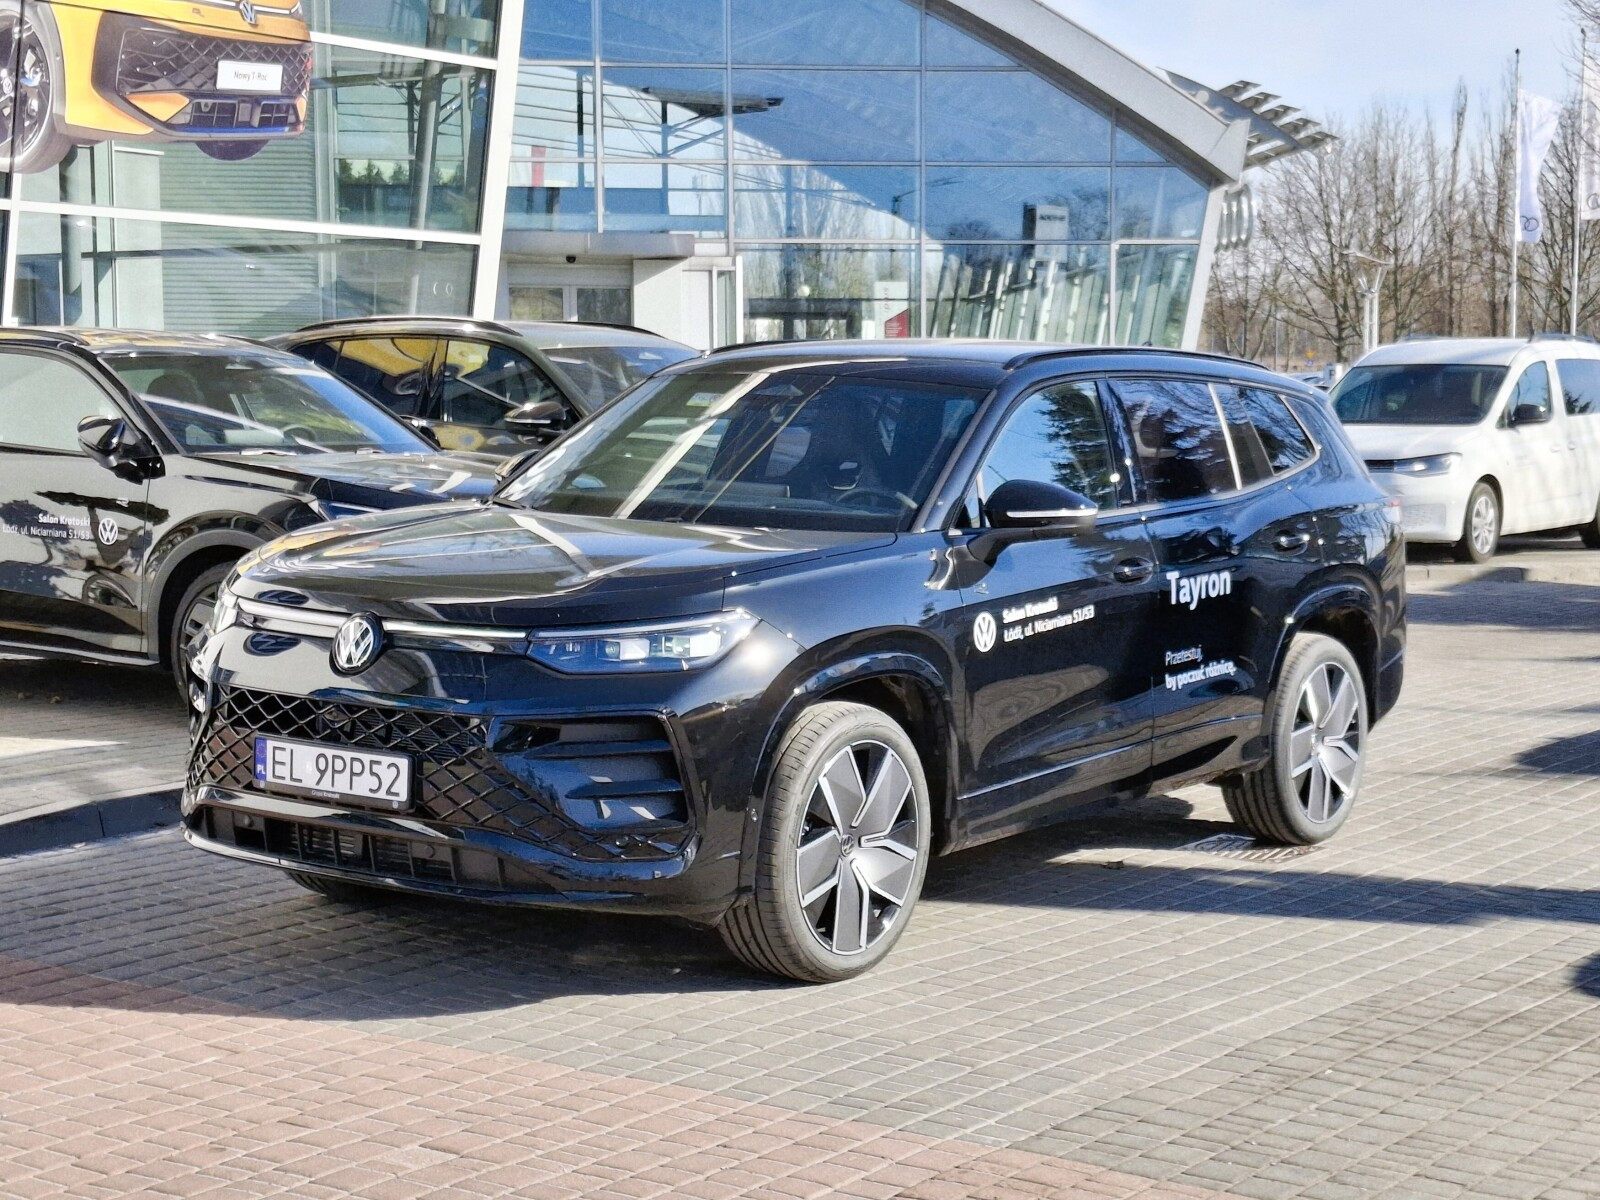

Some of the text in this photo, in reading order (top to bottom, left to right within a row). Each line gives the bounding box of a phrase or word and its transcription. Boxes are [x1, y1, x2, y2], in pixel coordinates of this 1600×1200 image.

[233, 71, 268, 82] Nowy T-Roc
[38, 513, 90, 527] Salon Krotoski
[68, 529, 90, 540] 51/53
[1166, 571, 1231, 611] Tayron
[1072, 604, 1096, 624] 51/53
[1165, 673, 1177, 692] by
[257, 764, 266, 775] PL
[272, 745, 400, 797] EL 9PP52
